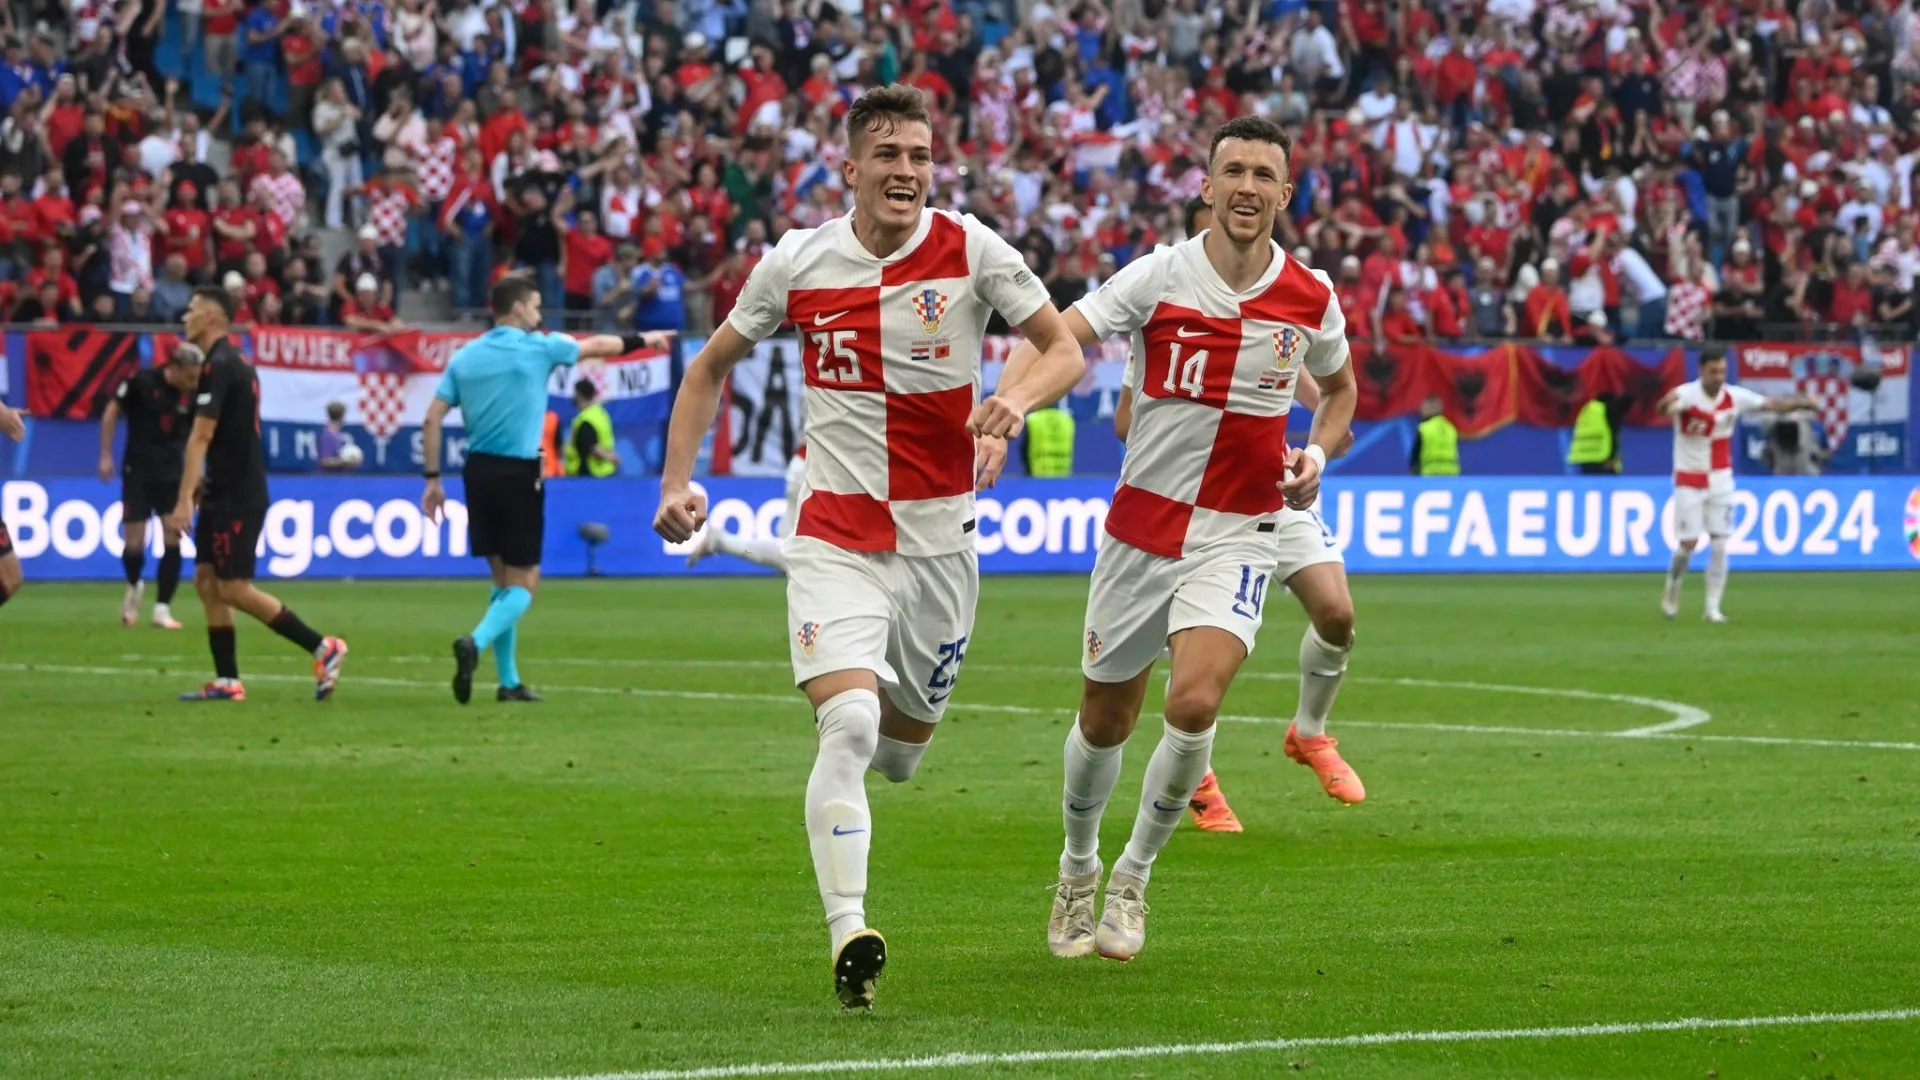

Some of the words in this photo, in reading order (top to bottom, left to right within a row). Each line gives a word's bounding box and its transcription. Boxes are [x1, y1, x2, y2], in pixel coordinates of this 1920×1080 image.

[257, 331, 352, 365] UVIJEK
[810, 330, 863, 383] 25
[1163, 341, 1209, 399] 14
[1727, 489, 1880, 556] 2024
